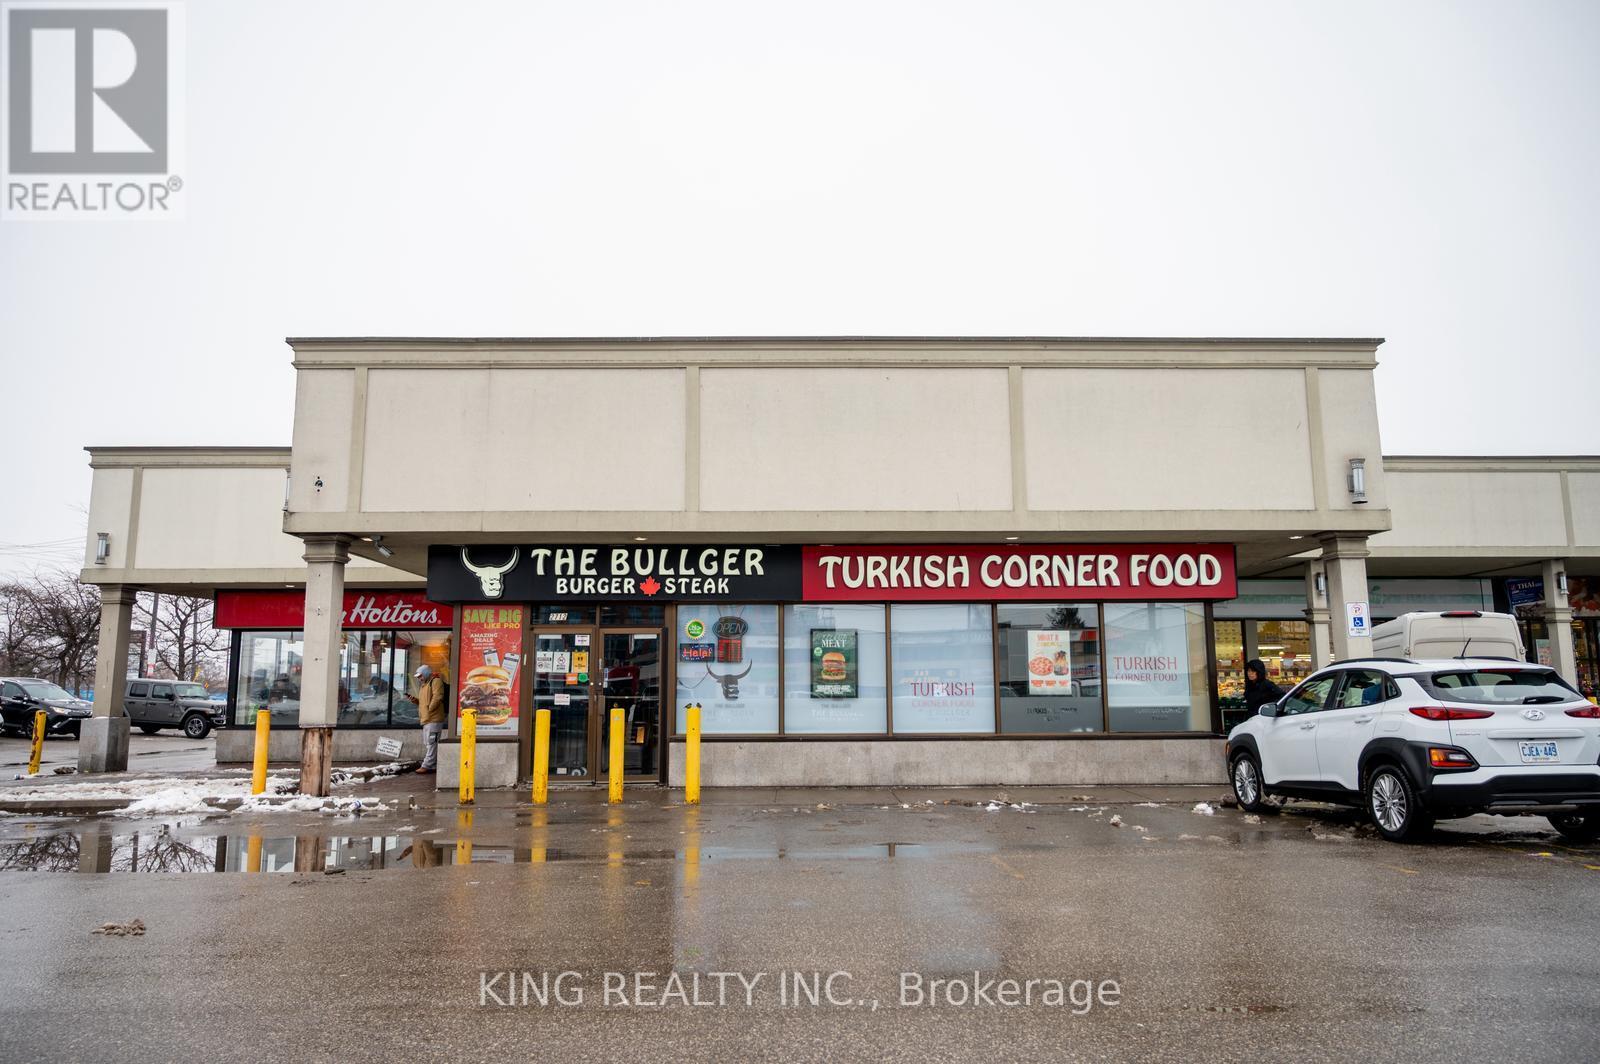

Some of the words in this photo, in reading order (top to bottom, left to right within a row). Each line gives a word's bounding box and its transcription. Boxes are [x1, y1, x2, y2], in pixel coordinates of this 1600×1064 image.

[531, 548, 598, 576] THE
[610, 548, 765, 576] BULLGER
[818, 555, 970, 588] TURKISH
[980, 554, 1121, 588] CORNER
[1129, 554, 1223, 587] FOOD
[555, 577, 637, 595] BURGER
[664, 577, 730, 595] STEAK
[349, 595, 438, 624] Hortons
[463, 609, 495, 623] SAVE
[499, 609, 522, 623] BIG
[718, 622, 745, 634] OPEN
[821, 639, 847, 648] MEAT
[1113, 656, 1178, 671] TURKISH
[1115, 672, 1152, 682] CORNER
[1153, 672, 1178, 682] FOOD
